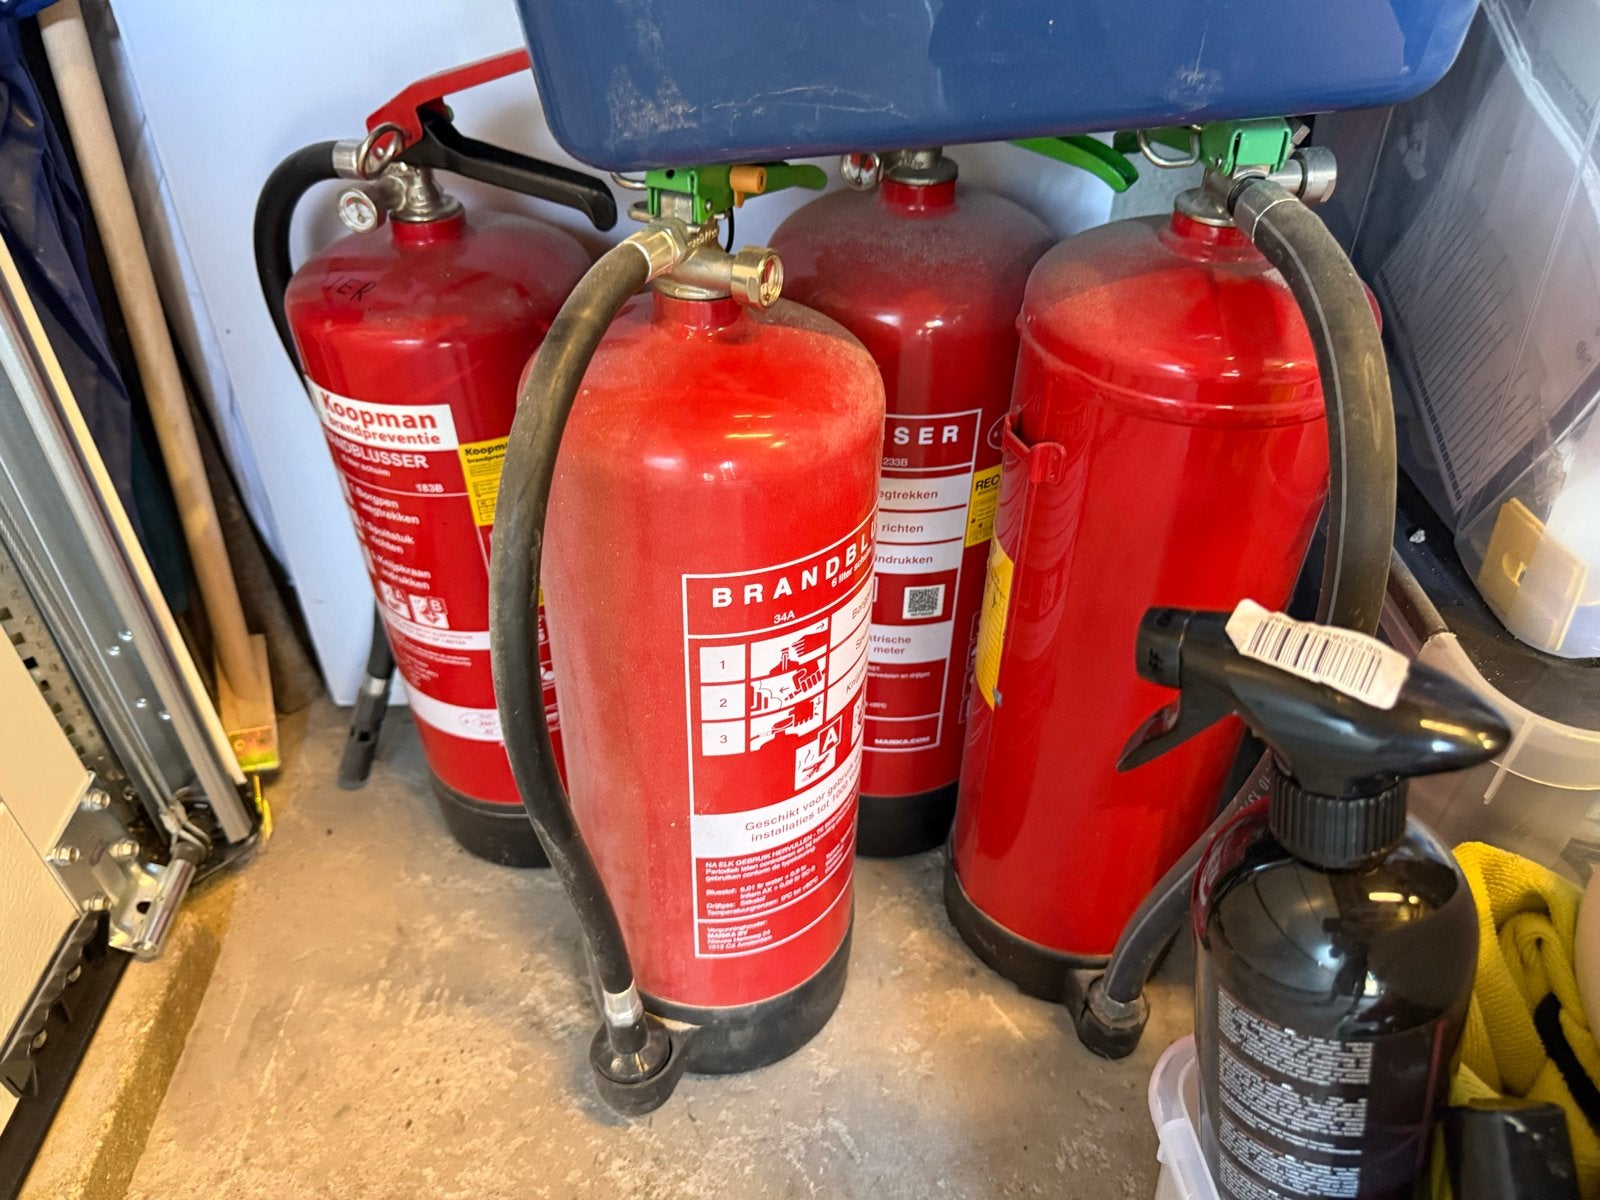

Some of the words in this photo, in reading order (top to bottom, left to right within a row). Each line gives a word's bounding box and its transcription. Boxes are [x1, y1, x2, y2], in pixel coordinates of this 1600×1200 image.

[320, 391, 437, 429] Koopman
[328, 412, 441, 445] brandpreventie
[893, 425, 959, 446] SER
[880, 489, 938, 501] egtrekken
[882, 523, 924, 534] richten
[831, 578, 838, 588] 6
[773, 610, 795, 625] 34A
[874, 646, 905, 655] meter
[719, 660, 726, 670] 1
[719, 698, 728, 708] 2
[719, 734, 728, 744] 3
[745, 807, 800, 831] Geschikt
[803, 792, 826, 811] voor
[751, 811, 814, 842] installaties
[817, 799, 830, 814] tot
[718, 860, 734, 868] ELK
[735, 853, 771, 866] GEBRUIK
